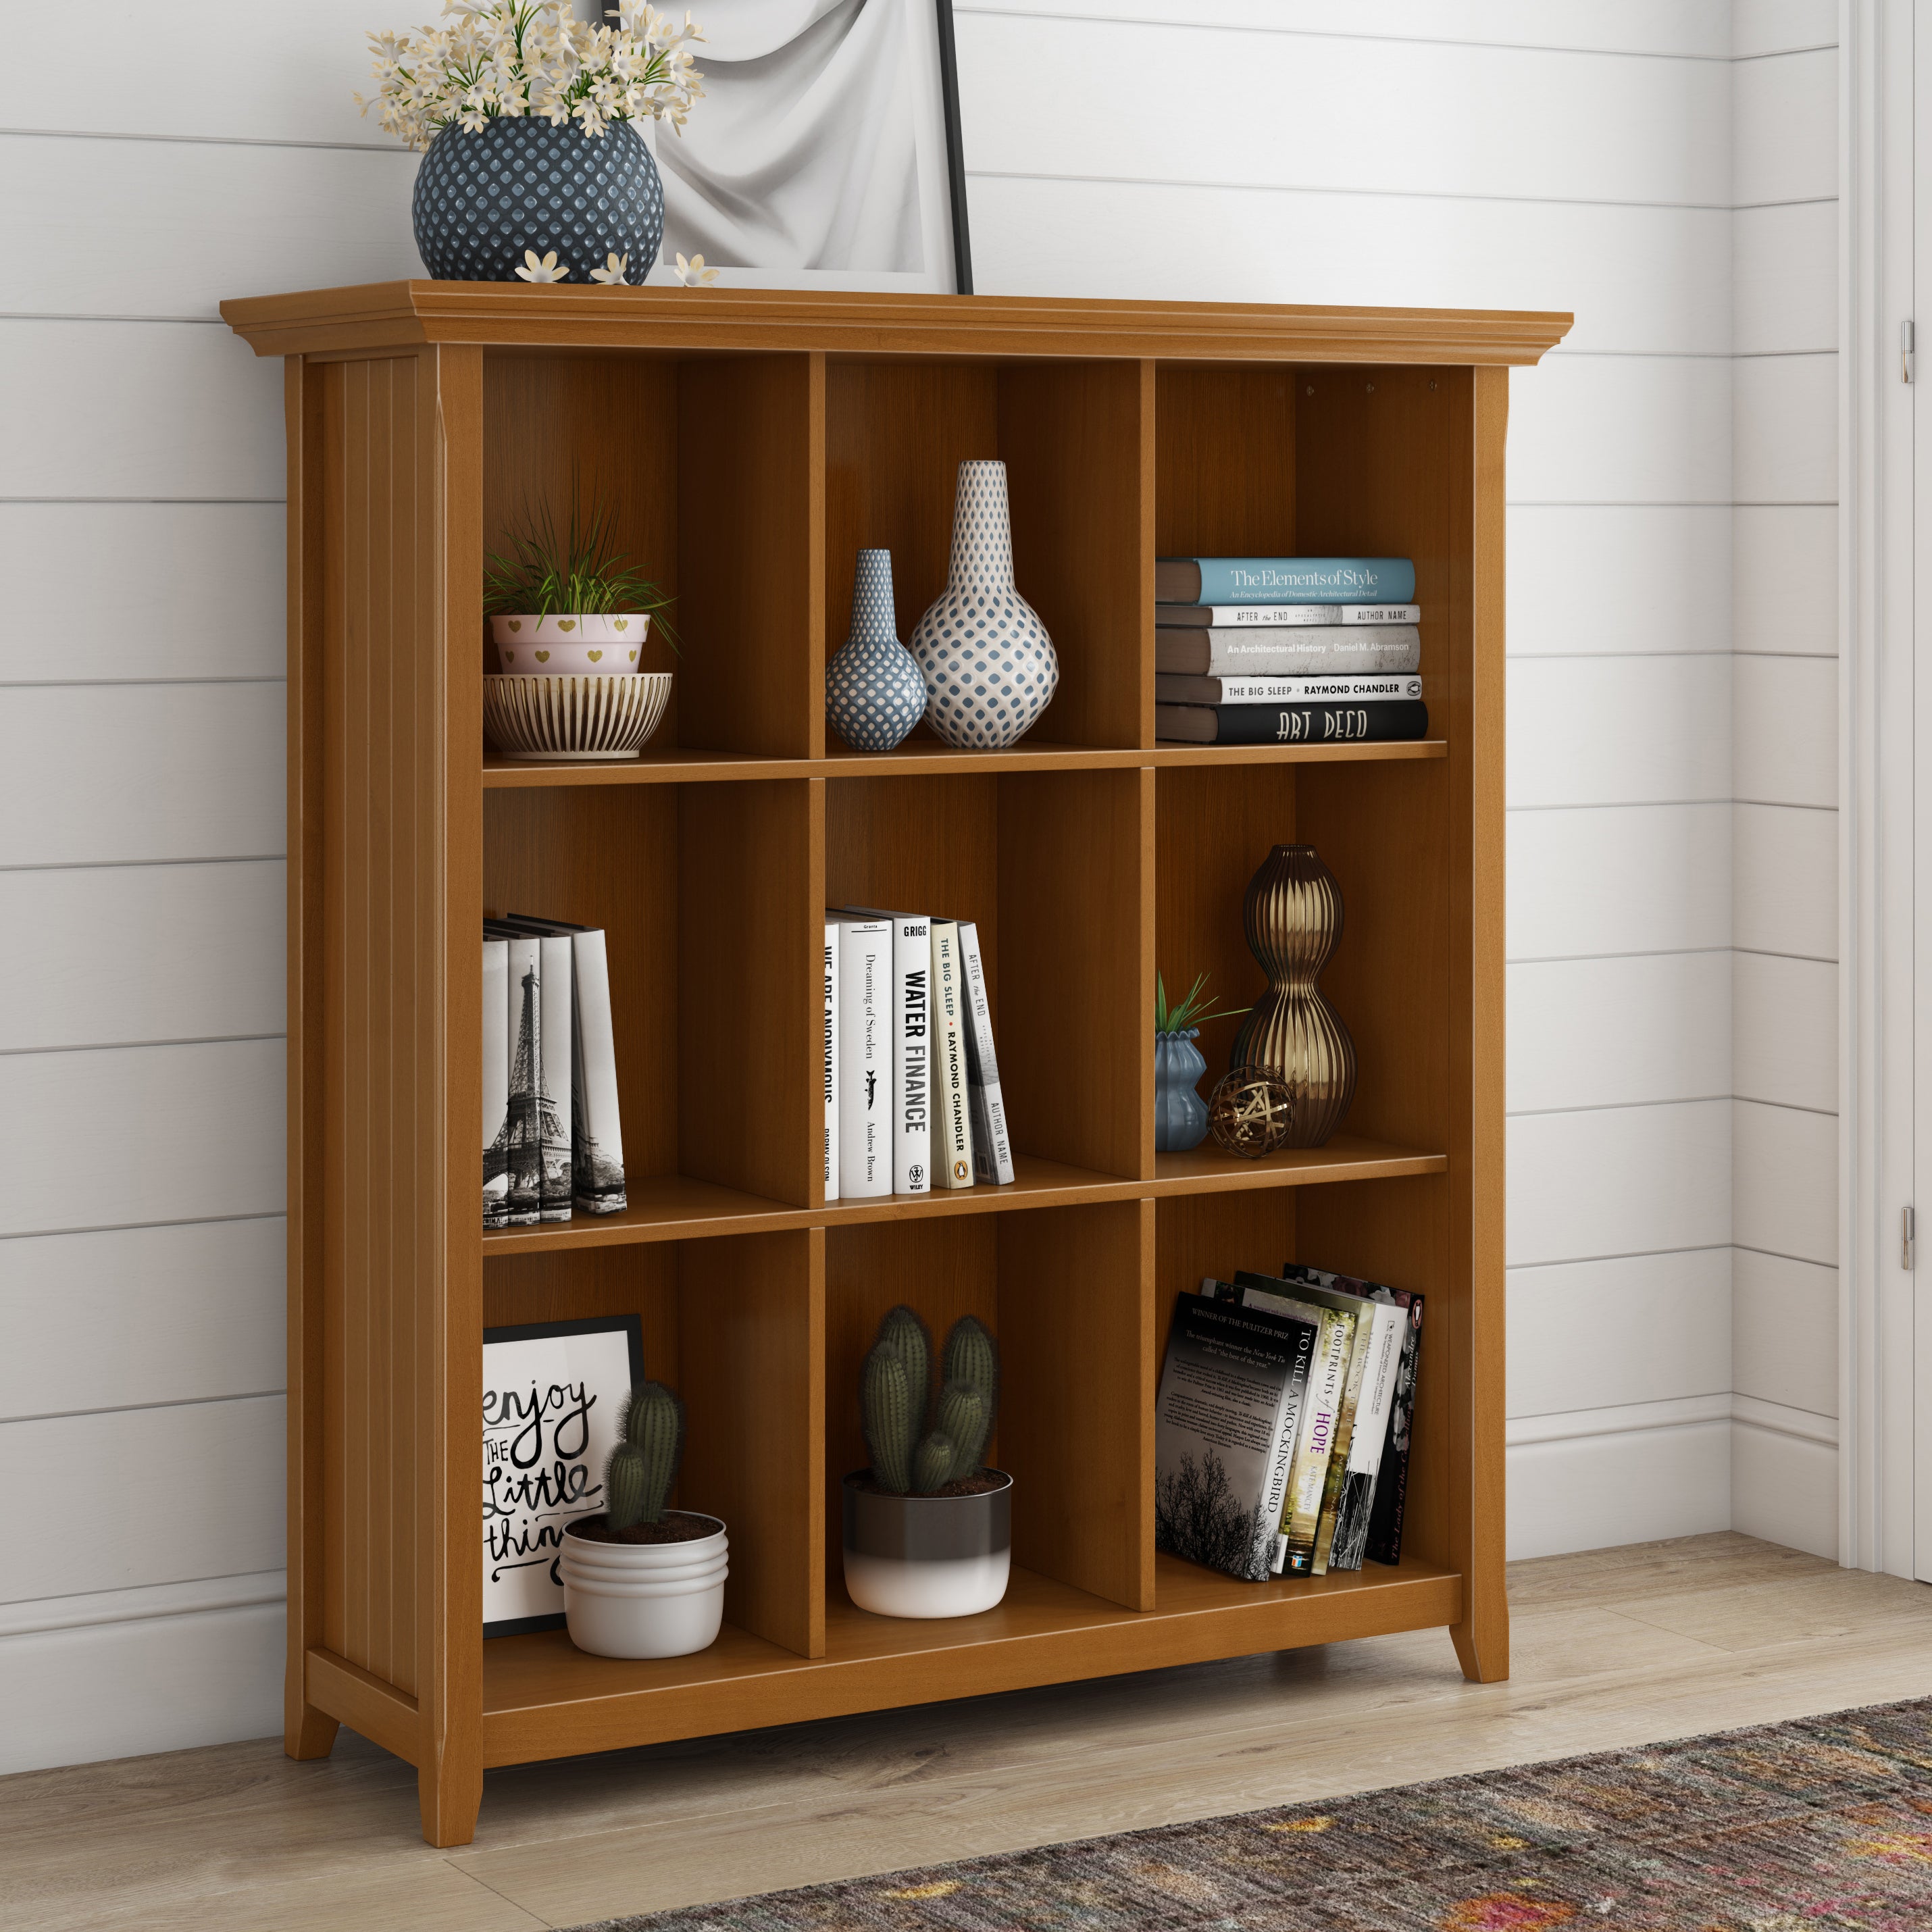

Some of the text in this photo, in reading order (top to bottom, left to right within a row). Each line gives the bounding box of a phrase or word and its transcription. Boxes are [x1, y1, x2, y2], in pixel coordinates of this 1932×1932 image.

[1231, 569, 1378, 589] The Elements of Style
[1240, 590, 1281, 599] Encyclopedia
[1237, 612, 1258, 621] AFTER
[1273, 612, 1288, 621] END
[1358, 611, 1406, 620] AUTHOR NAME
[1227, 644, 1327, 654] An Architectural History
[1333, 643, 1409, 651] Daniel M. Abramson
[1229, 684, 1400, 696] THE BIG SLEEP RAYMOND CHANDLER
[1277, 710, 1367, 740] ART DECO
[904, 925, 927, 936] GRIGG
[969, 955, 980, 981] AFTER
[976, 998, 985, 1016] END
[863, 955, 876, 1059] Dreaming of Sweden
[905, 970, 925, 1133] WATER FINANCE
[941, 938, 964, 1151] THE BIG SLEEP RAYMOND CHANDLER
[991, 1102, 1008, 1165] AUTHOR NAME
[867, 1121, 875, 1181] Andrew Brown
[1192, 1308, 1217, 1320] WINNER
[1219, 1315, 1228, 1323] OF
[1228, 1317, 1242, 1327] THE
[1243, 1321, 1273, 1336] PULITZER
[1186, 1329, 1196, 1338] The
[1196, 1333, 1224, 1346] triumphant
[1225, 1342, 1243, 1351] winner
[1252, 1348, 1265, 1358] New
[1265, 1352, 1276, 1361] York
[1202, 1346, 1217, 1354] called
[1229, 1352, 1240, 1361] best
[1247, 1356, 1255, 1365] the
[1324, 1324, 1344, 1394] FOOTPRINTS
[1352, 1358, 1363, 1390] BOOK
[1374, 1333, 1393, 1415] WEAPONIZED ARCHITECTURE
[1405, 1336, 1416, 1388] Alexandre
[1316, 1394, 1336, 1413] of
[482, 1380, 597, 1469] enjoy
[1267, 1329, 1312, 1512] TO KILL A MOCKINGBIRD
[1311, 1413, 1331, 1454] HOPE
[483, 1439, 508, 1465] THE
[482, 1461, 603, 1520] Little
[1333, 1456, 1344, 1493] AUTHOR
[1396, 1484, 1406, 1500] of
[1393, 1502, 1404, 1534] Lady
[1390, 1535, 1399, 1559] The
